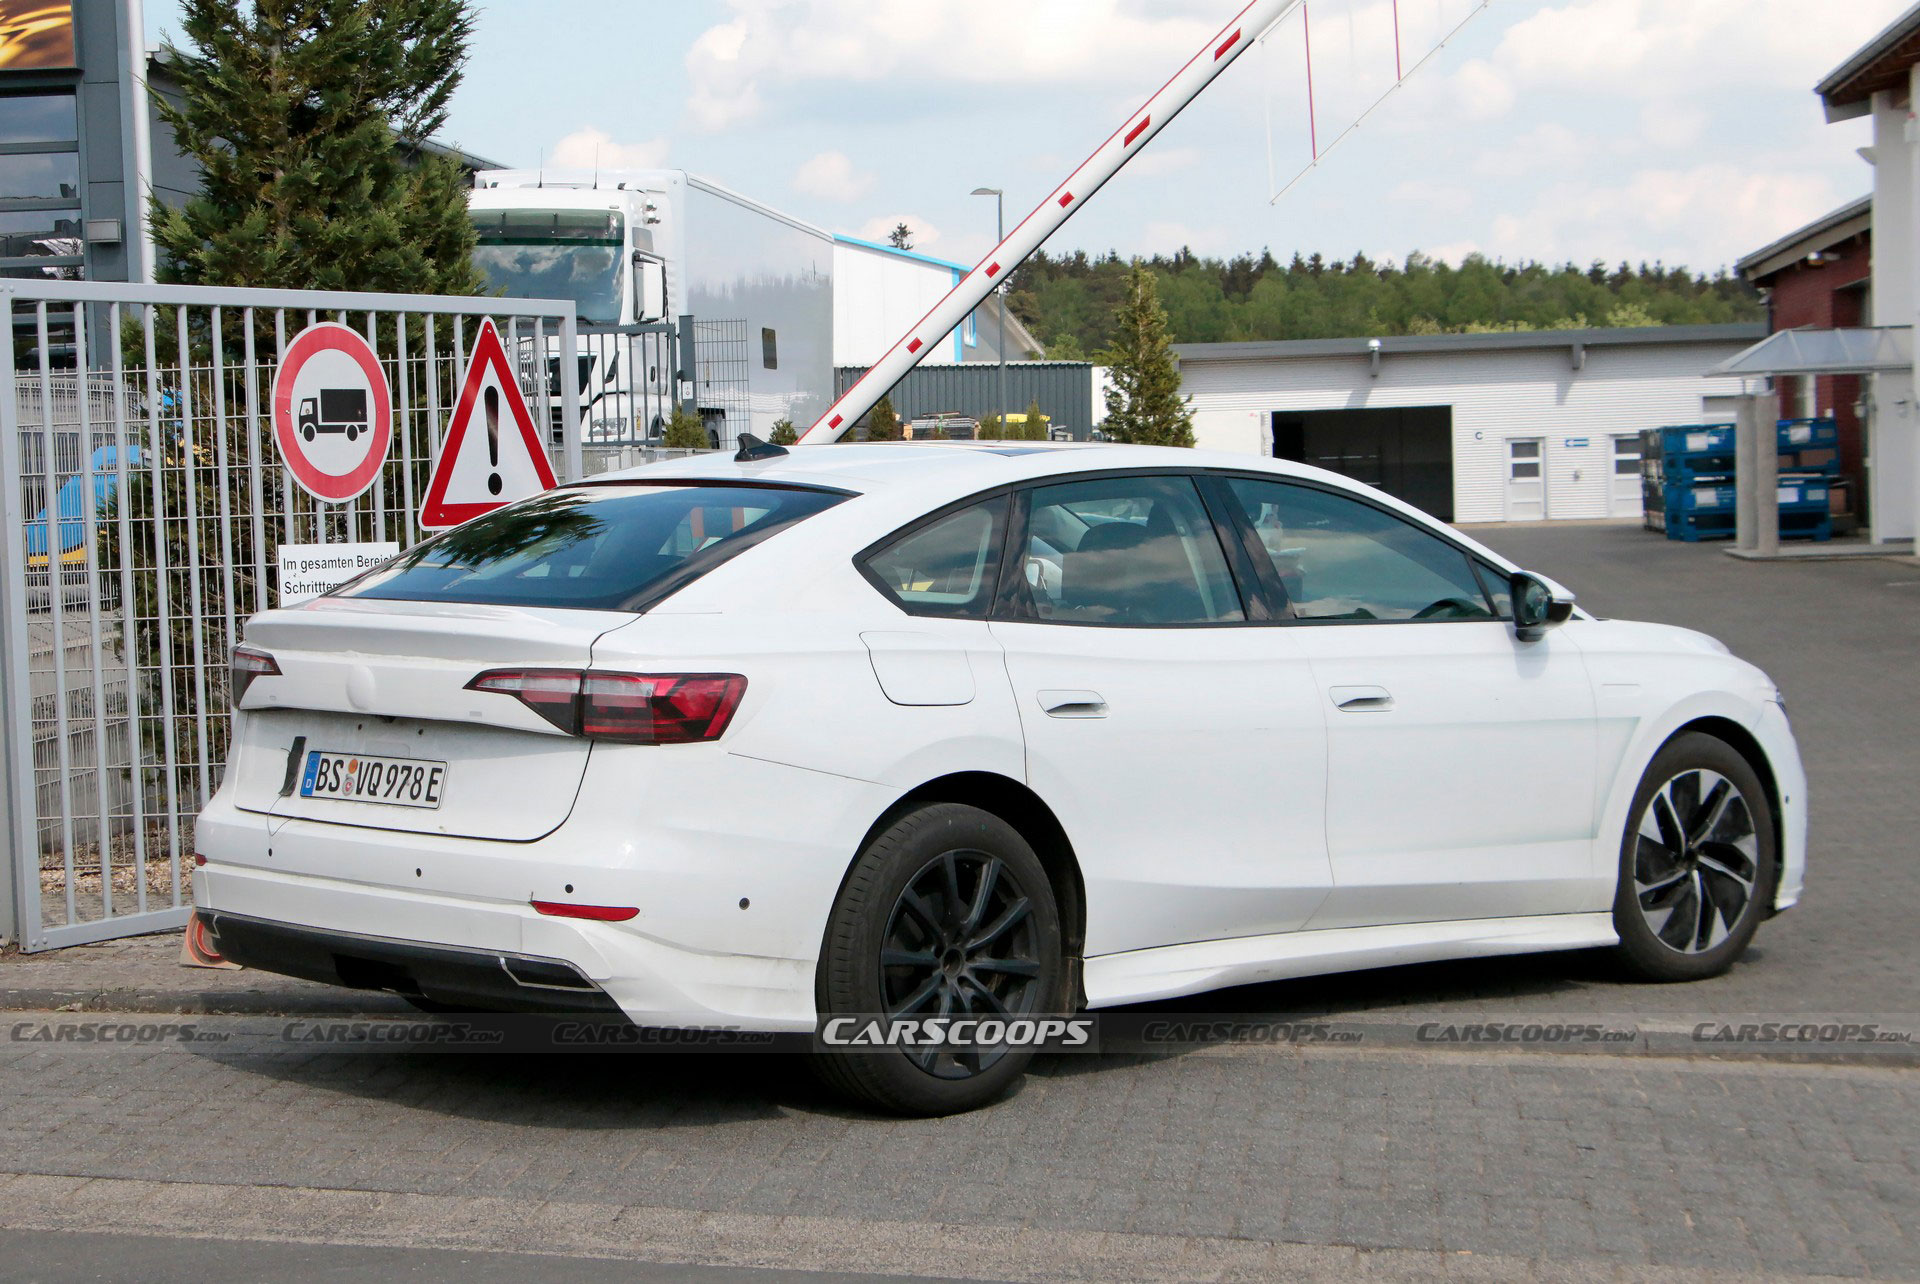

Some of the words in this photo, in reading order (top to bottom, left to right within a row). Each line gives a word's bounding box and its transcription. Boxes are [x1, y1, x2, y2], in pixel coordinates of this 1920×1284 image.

[1475, 431, 1484, 441] C
[283, 558, 297, 570] Im
[300, 556, 353, 574] gesamten
[356, 554, 392, 568] Berei
[315, 758, 344, 792] BS
[305, 778, 312, 788] D
